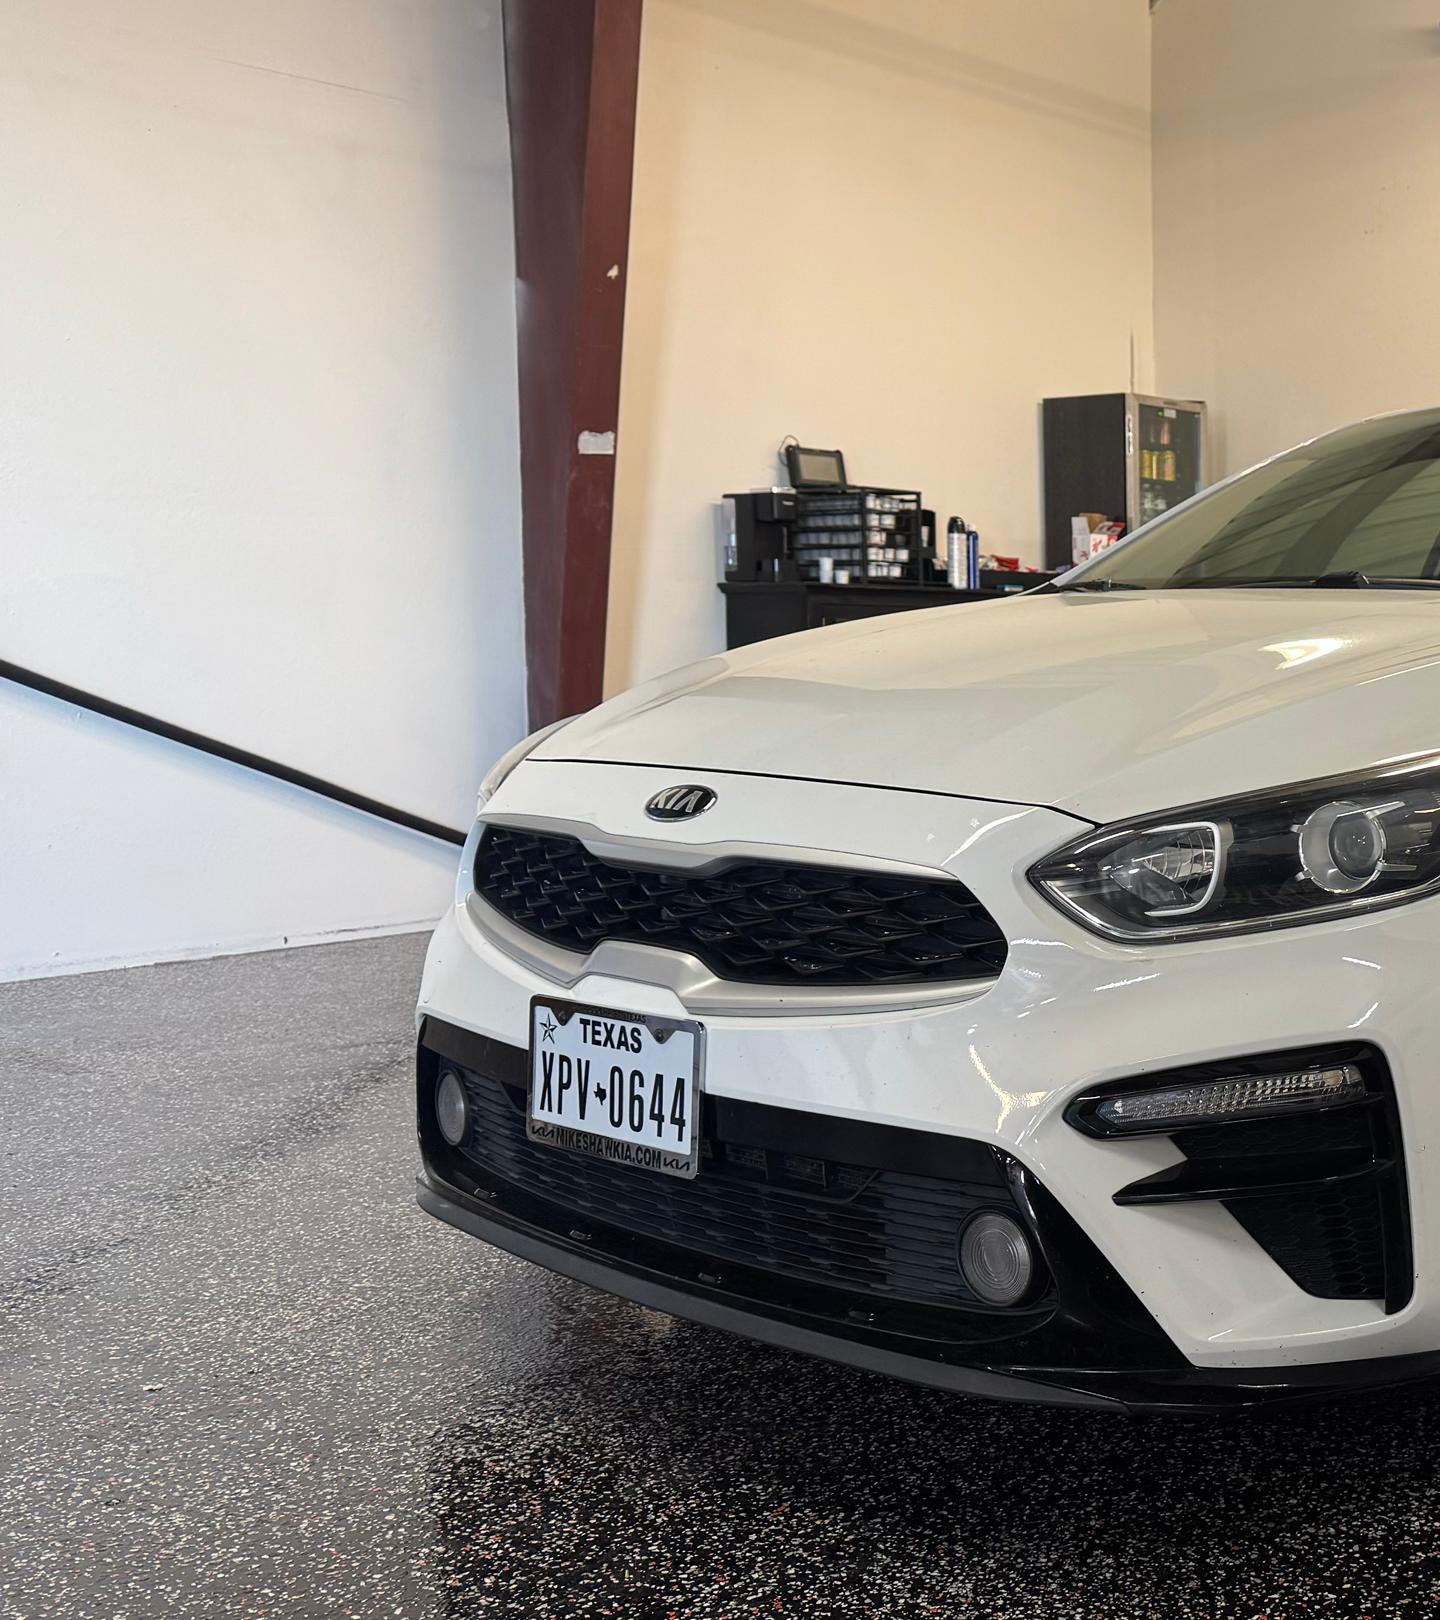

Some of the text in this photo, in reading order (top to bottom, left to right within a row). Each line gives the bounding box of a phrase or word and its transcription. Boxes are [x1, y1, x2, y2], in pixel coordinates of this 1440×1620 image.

[649, 788, 704, 813] KIA
[579, 1017, 643, 1054] TEXAS
[556, 1127, 662, 1169] MIKESHAWKIA.COM
